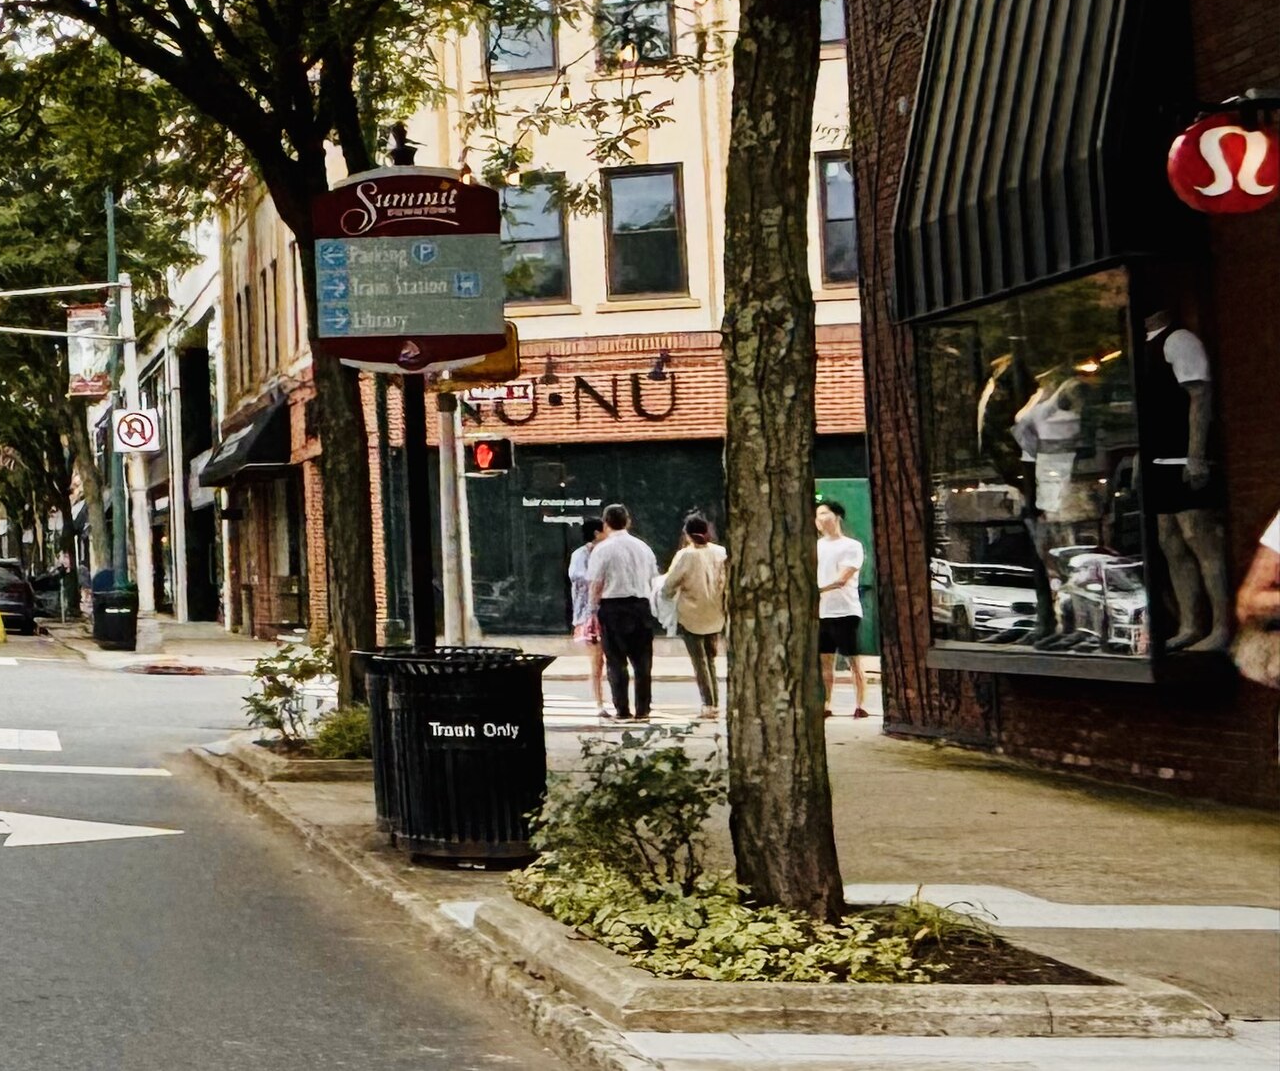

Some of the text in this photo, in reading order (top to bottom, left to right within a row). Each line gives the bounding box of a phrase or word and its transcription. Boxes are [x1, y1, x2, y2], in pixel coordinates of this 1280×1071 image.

[341, 182, 458, 236] Summit
[348, 245, 409, 268] Parking
[351, 276, 448, 296] Train Station
[352, 311, 409, 332] Library
[428, 721, 520, 740] Trash Only
